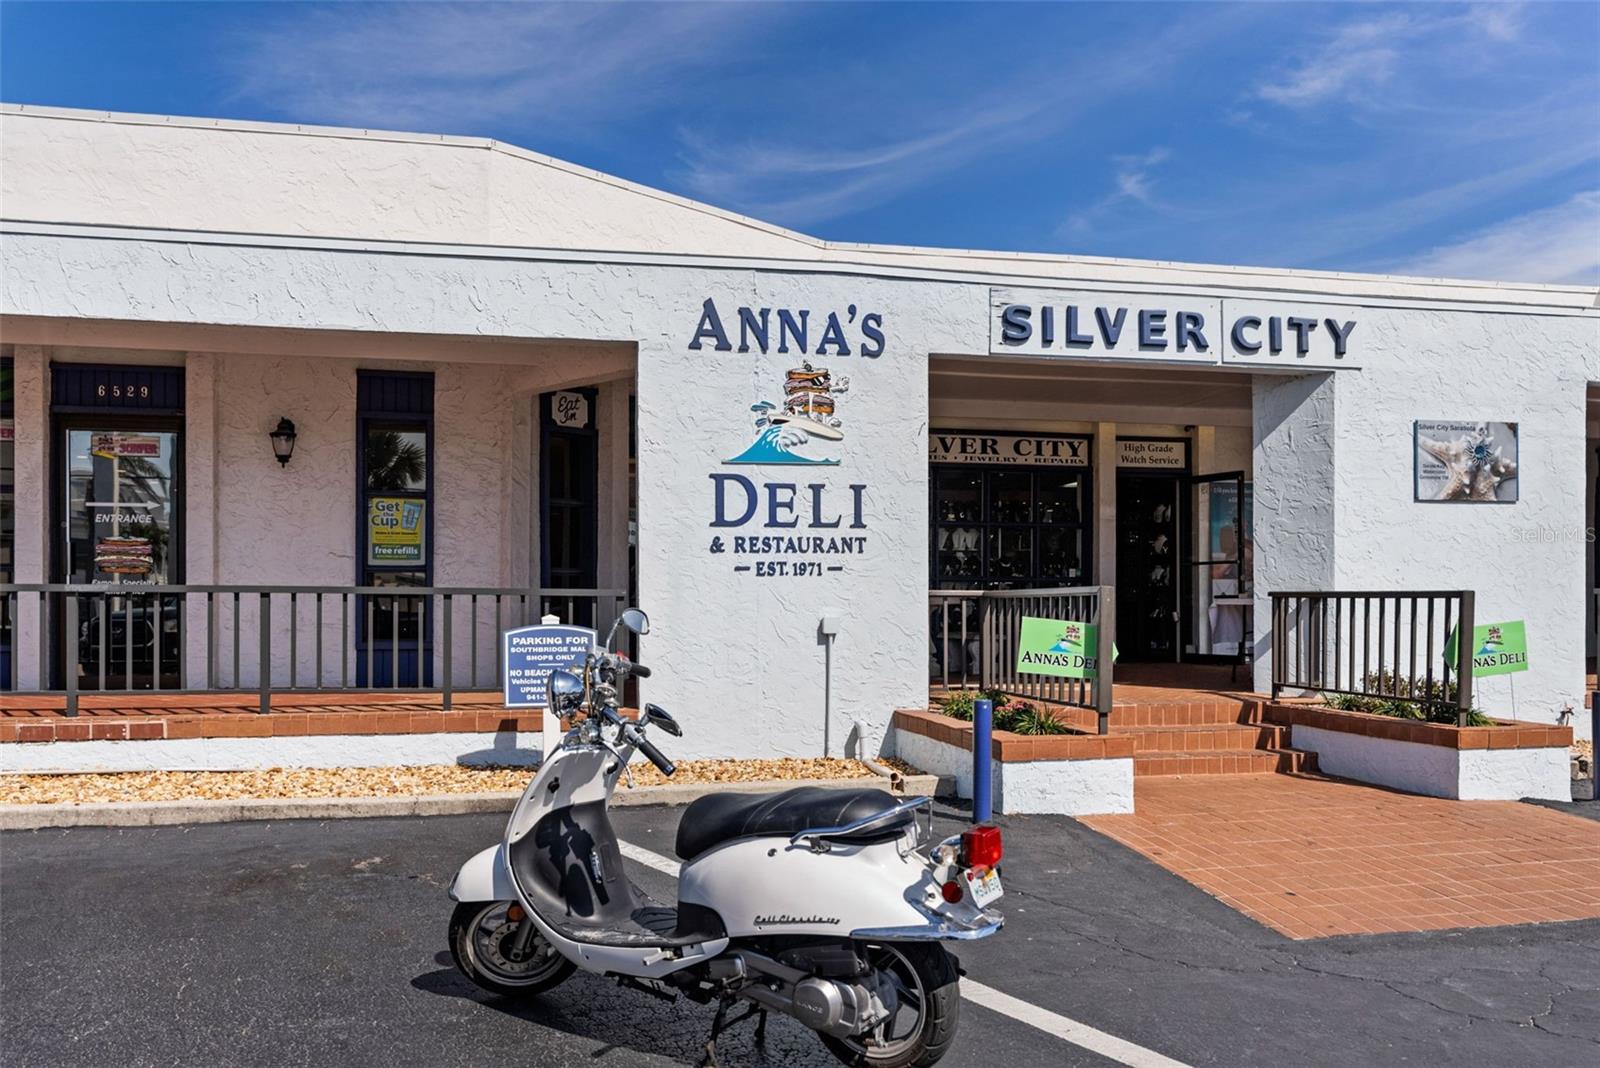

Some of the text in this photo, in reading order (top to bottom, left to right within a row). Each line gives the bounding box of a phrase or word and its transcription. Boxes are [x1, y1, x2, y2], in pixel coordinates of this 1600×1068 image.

[688, 297, 885, 358] ANNA'S
[1001, 304, 1356, 359] SILVER CITY
[98, 384, 149, 397] 6529
[558, 396, 580, 414] Eat
[559, 411, 577, 424] In
[1013, 439, 1084, 457] CITY
[1124, 443, 1174, 453] High Grade
[1121, 455, 1179, 464] Watch Service
[375, 501, 400, 512] Get
[709, 473, 867, 528] DELI
[95, 514, 153, 523] ENTRANCE
[371, 515, 399, 529] Cup
[375, 546, 418, 555] free refills
[710, 537, 866, 554] & RESTAURANT
[756, 562, 822, 576] EST. 1971
[513, 637, 562, 645] PARKING
[1022, 651, 1069, 666] ANNA'S
[1474, 653, 1525, 668] NA'S DELI
